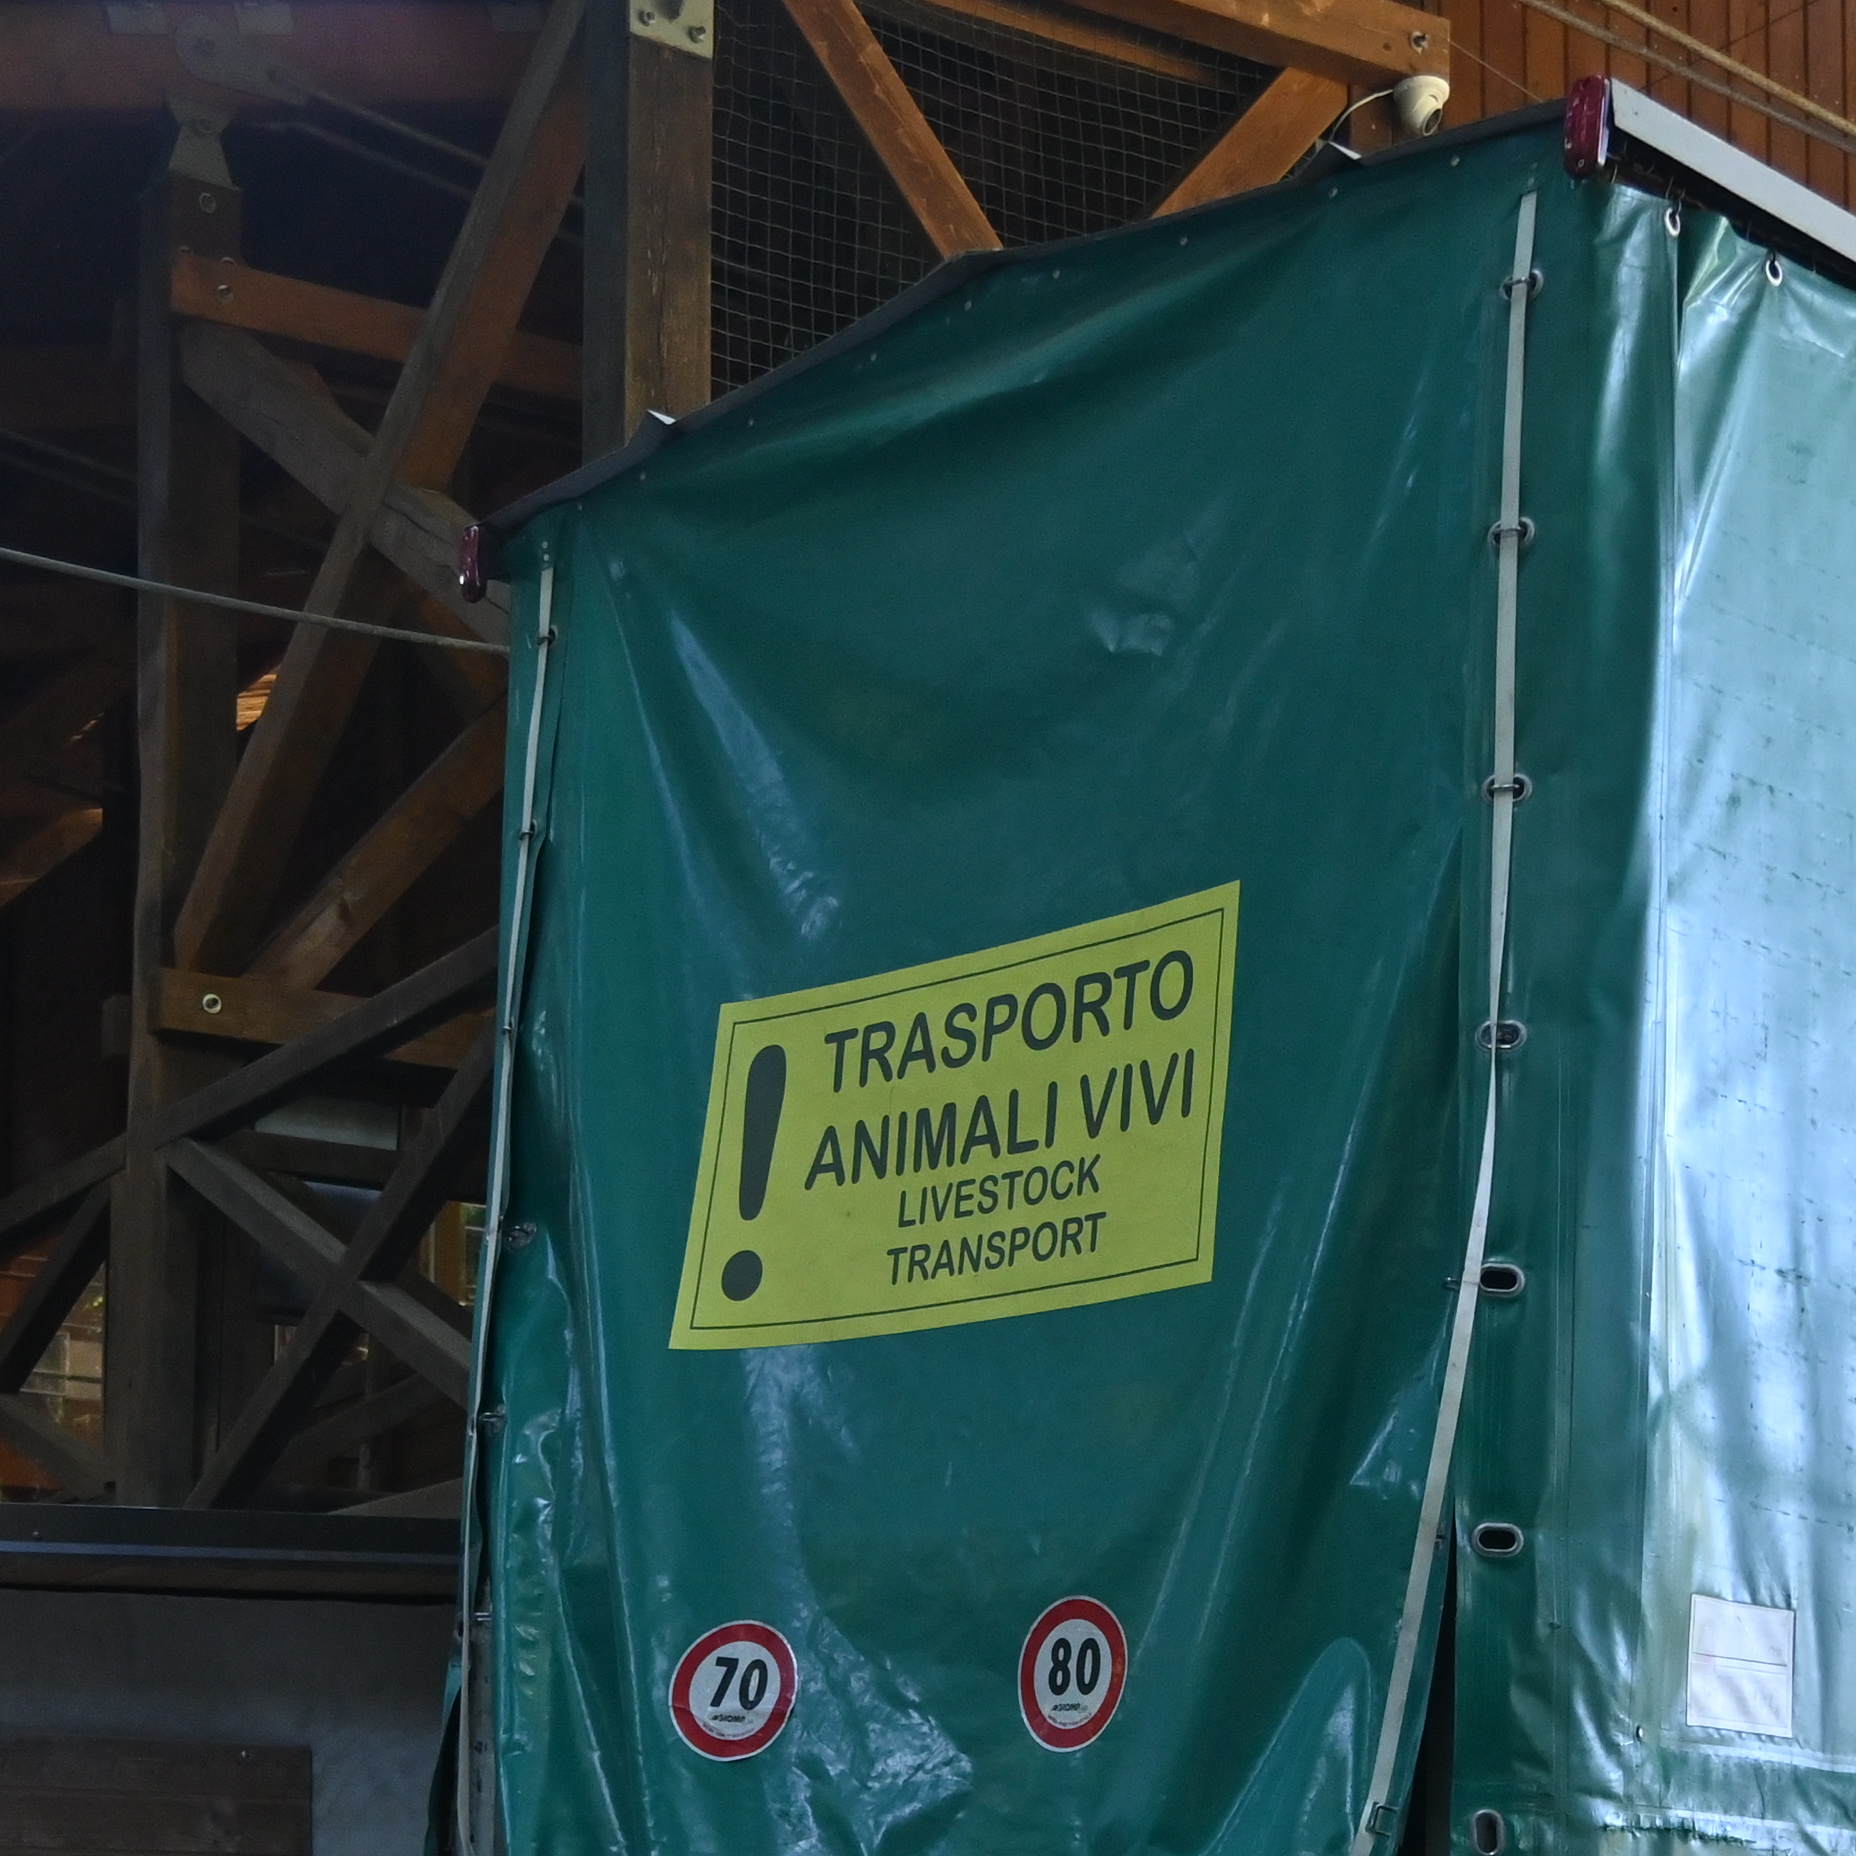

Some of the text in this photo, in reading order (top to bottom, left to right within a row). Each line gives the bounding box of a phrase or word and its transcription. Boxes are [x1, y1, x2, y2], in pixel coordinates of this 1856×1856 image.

[824, 950, 1194, 1092] TRASPORTO
[804, 1049, 1194, 1190] ANIMALI VIVI
[897, 1154, 1101, 1227] LIVESTOCK
[886, 1212, 1107, 1285] TRANSPORT
[710, 1656, 768, 1711] 70
[1048, 1637, 1101, 1696] 80
